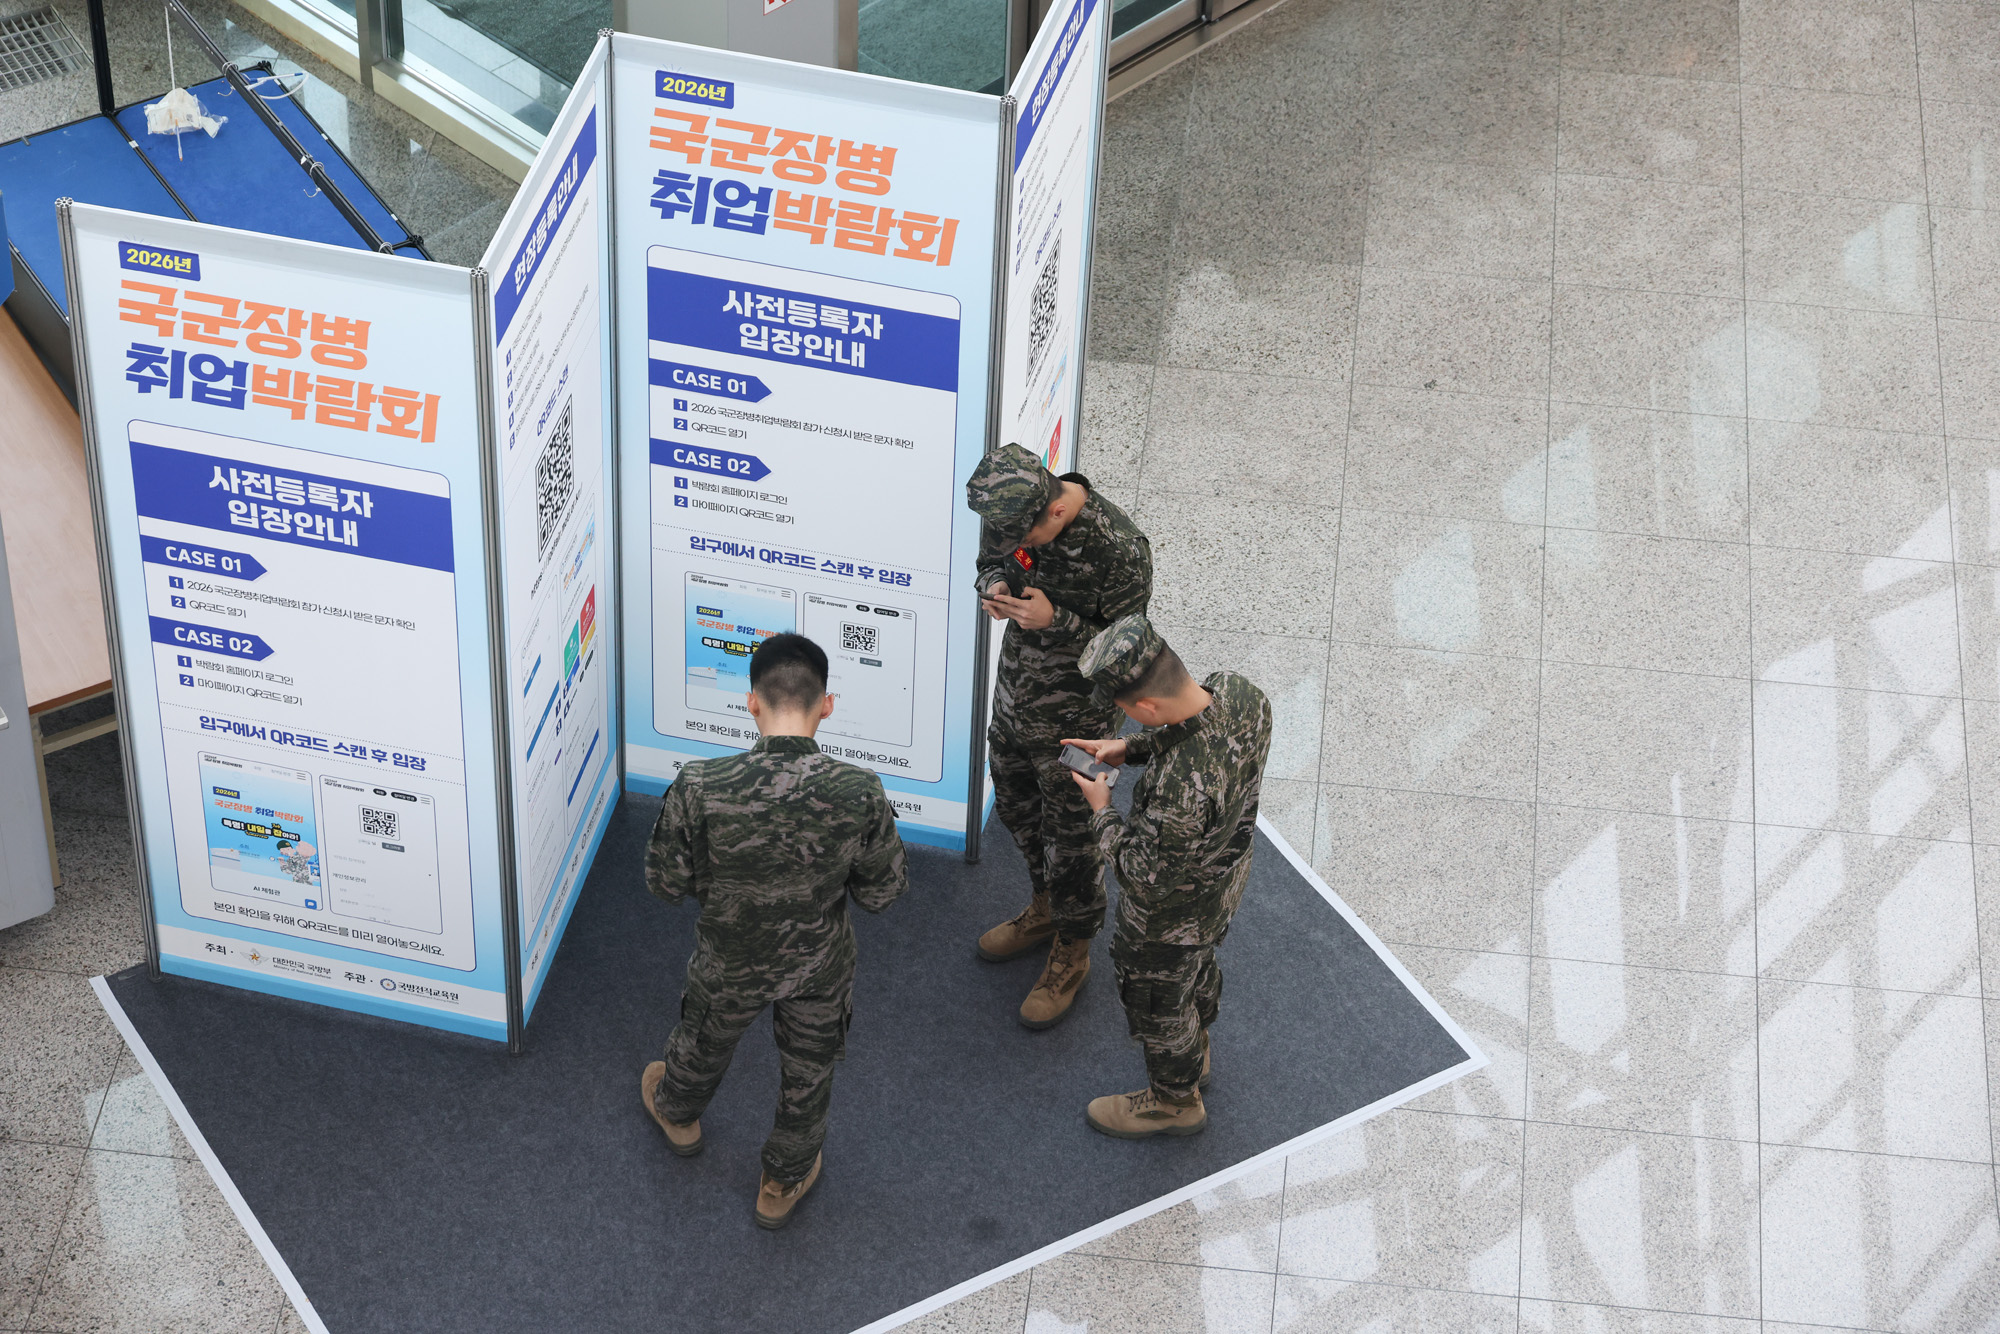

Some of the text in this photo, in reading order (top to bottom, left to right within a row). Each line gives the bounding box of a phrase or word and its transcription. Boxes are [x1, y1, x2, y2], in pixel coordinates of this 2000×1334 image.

[662, 76, 727, 102] 2026년
[649, 107, 898, 196] 국군장병
[514, 151, 579, 296] 현장등록안내
[650, 168, 960, 266] 취업박람회
[126, 248, 192, 274] 2026년
[118, 279, 372, 371] 국군장병
[722, 289, 884, 340] 사전등록자
[739, 322, 866, 369] 입장안내
[125, 342, 441, 443] 취업박람회
[672, 368, 747, 395] CASE 01
[691, 403, 717, 416] 2026
[717, 407, 802, 430] 국군장병취업박람회
[823, 425, 852, 439] 신청시
[853, 430, 873, 442] 받은
[873, 434, 894, 447] 문자
[894, 437, 914, 450] 확인
[691, 422, 727, 436] QR코드
[728, 428, 747, 440] 열기
[673, 448, 751, 475] CASE 02
[208, 465, 374, 519] 사전등록자
[691, 479, 720, 493] 박람회
[721, 483, 758, 500] 홈페이지
[759, 492, 788, 505] 로그인
[227, 499, 359, 548] 입장안내
[692, 498, 738, 516] 마이페이지
[739, 505, 774, 522] QR코드
[775, 512, 794, 525] 열기
[165, 545, 242, 573] CASE 01
[690, 535, 912, 587] 입구에서 QR코드 스캔 후 입장
[187, 579, 214, 594] 2026
[214, 585, 301, 610] 국군장병취업박람회
[322, 605, 353, 620] 신청시
[353, 610, 373, 623] 받은
[374, 614, 395, 628] 문자
[395, 618, 416, 632] 확인
[189, 600, 226, 615] QR코드
[227, 606, 247, 619] 열기
[174, 626, 254, 655] CASE 02
[736, 625, 779, 638] 취업박람
[195, 658, 224, 673] 박람회
[226, 663, 264, 680] 홈페이지
[265, 672, 294, 686] 로그인
[197, 678, 245, 695] 마이페이지
[246, 686, 283, 703] QR코드
[283, 693, 303, 707] 열기
[199, 715, 426, 772] 입구에서 QR코드 스캔 후 입장
[685, 720, 706, 732] 본인
[709, 724, 741, 738] 확인을
[820, 743, 842, 756] 미리
[844, 747, 912, 769] 열어놓으세요.
[213, 901, 445, 957] 본인 확인을 위해 QR코드를 미리 열어놓으세요.
[205, 942, 227, 955] 주최
[272, 957, 305, 970] 대한민국
[344, 971, 366, 984] 주관
